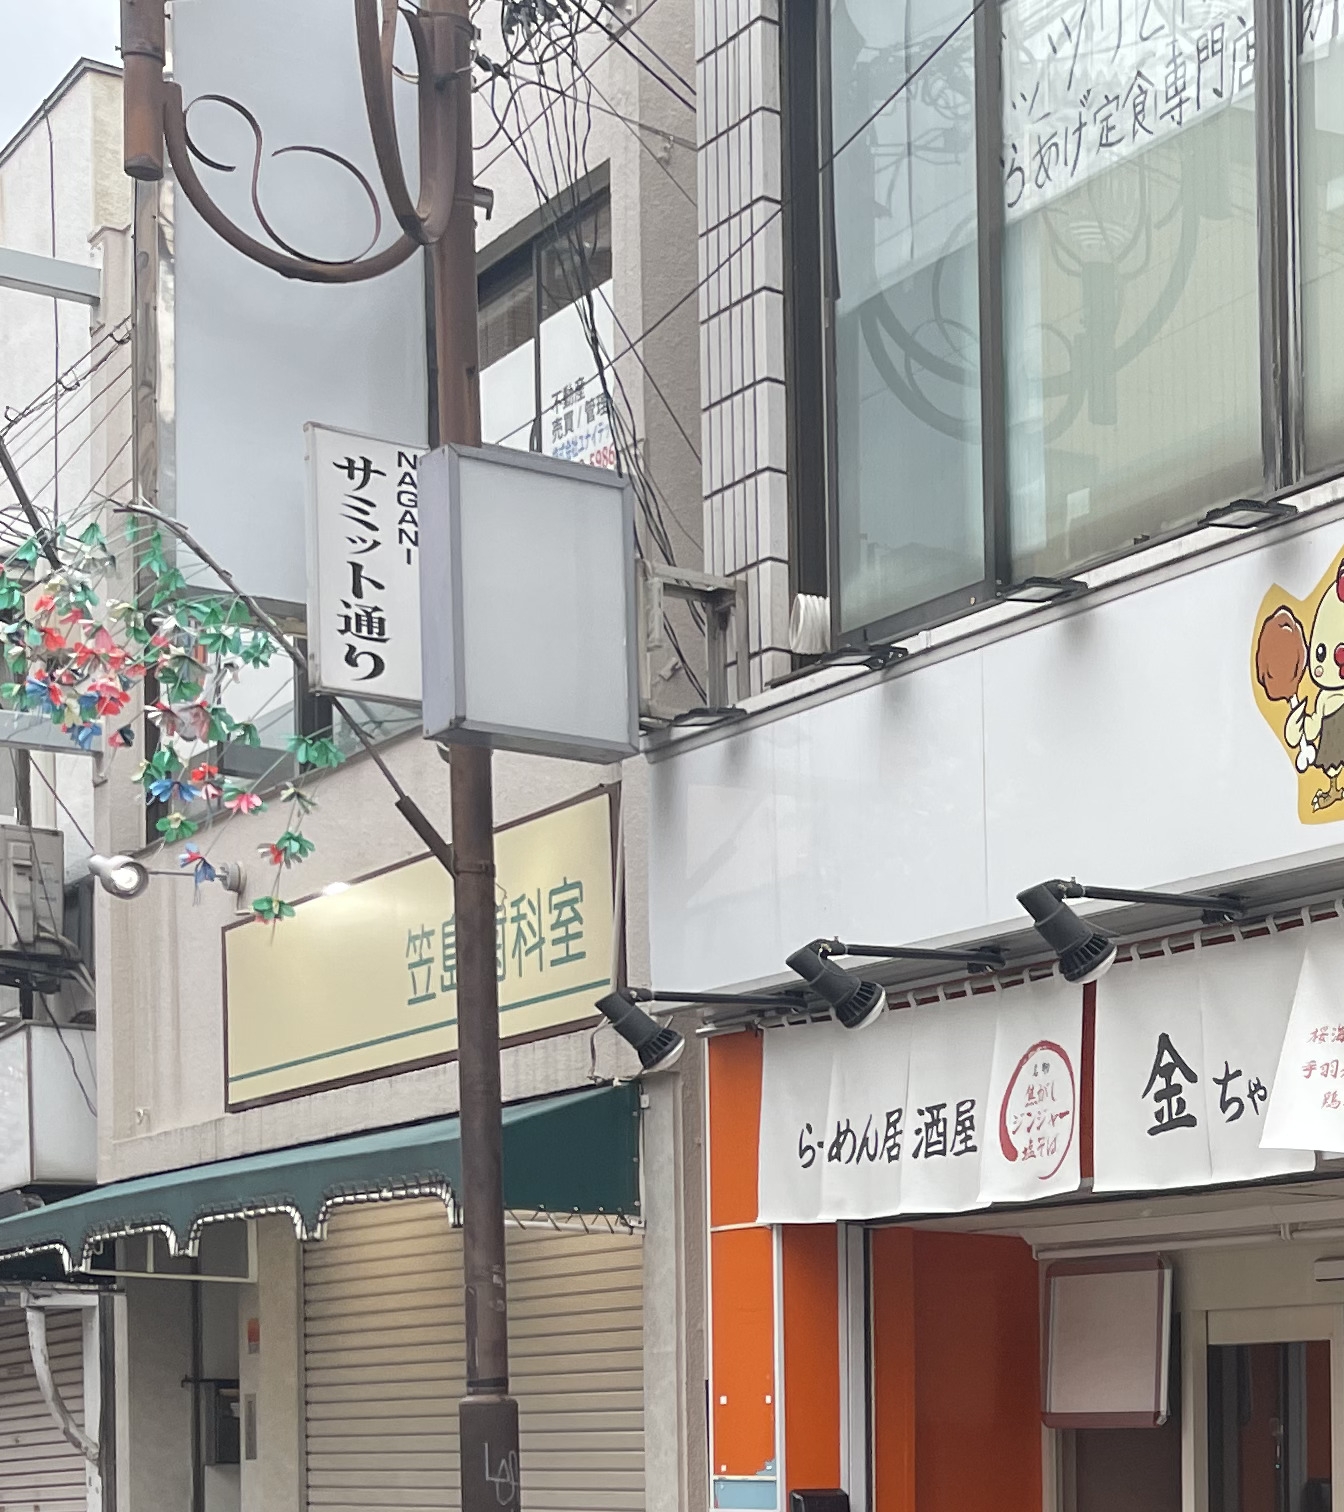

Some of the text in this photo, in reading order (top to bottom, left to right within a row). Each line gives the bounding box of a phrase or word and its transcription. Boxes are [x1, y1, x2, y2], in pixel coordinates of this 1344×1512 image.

[332, 455, 391, 681] サミット通り
